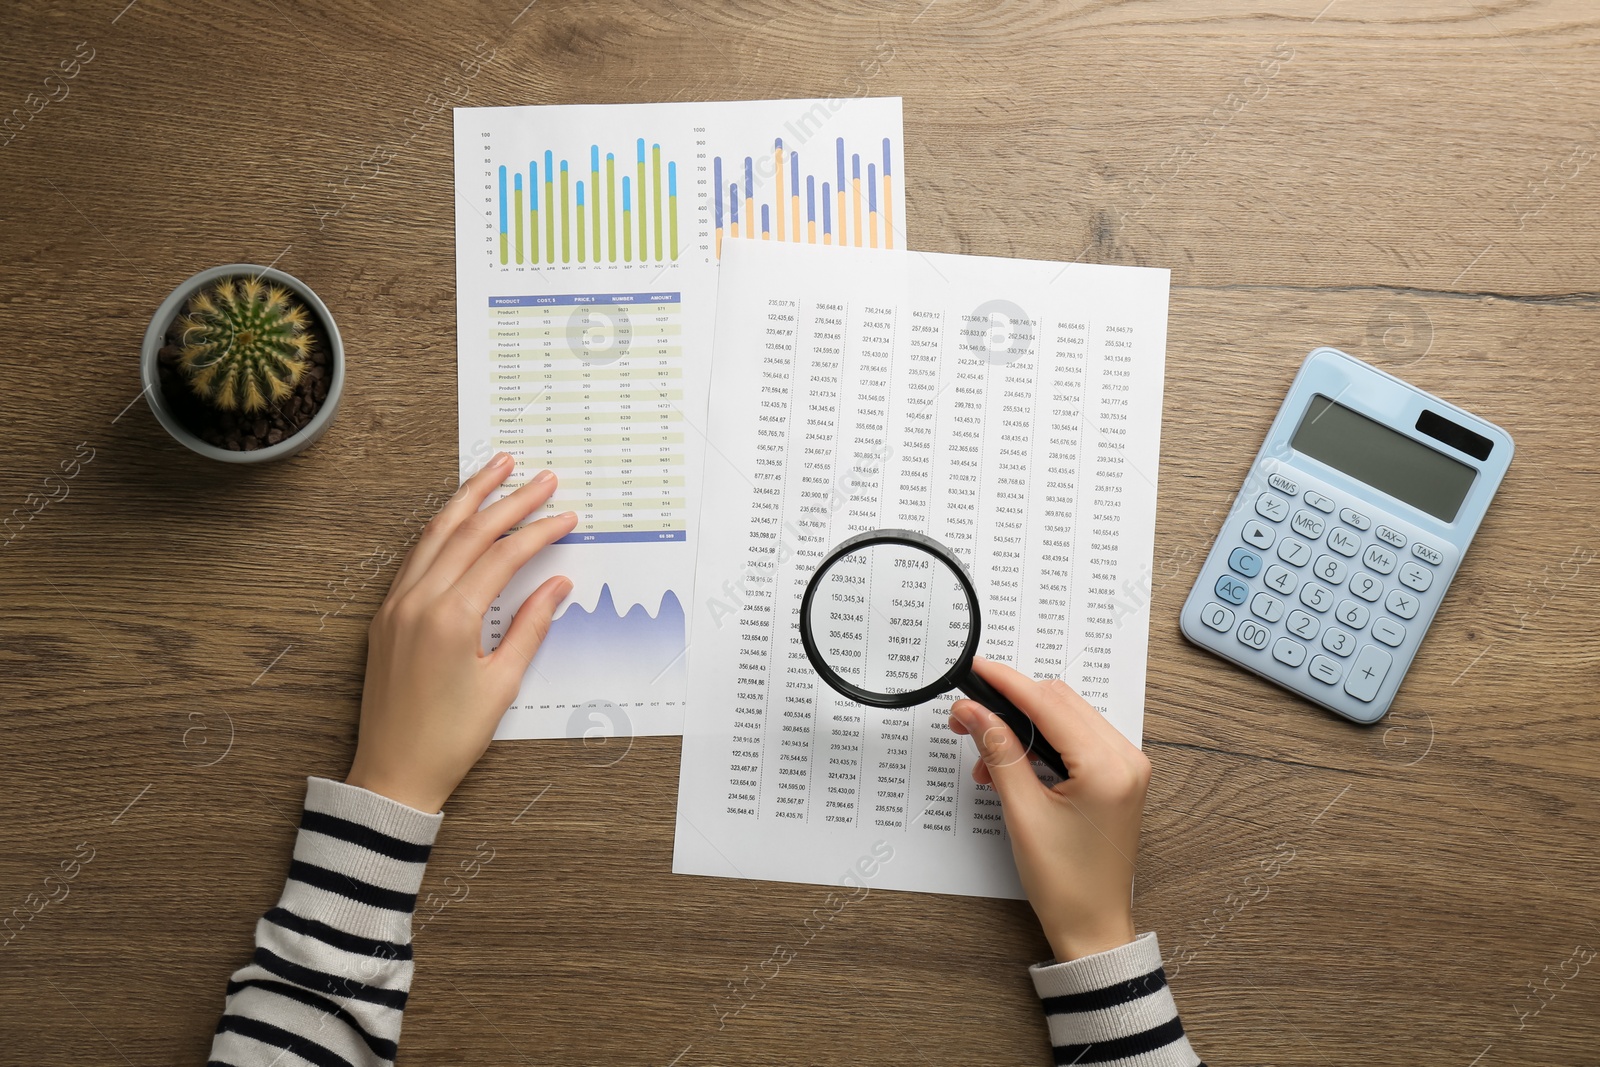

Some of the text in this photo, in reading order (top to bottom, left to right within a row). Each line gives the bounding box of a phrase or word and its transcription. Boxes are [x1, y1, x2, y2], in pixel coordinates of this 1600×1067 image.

[1273, 477, 1296, 492] H/M/S
[1295, 515, 1322, 534] MRC
[1291, 544, 1302, 558] 7
[1416, 545, 1438, 561] TAX+
[894, 559, 928, 569] 378,974,43
[1239, 556, 1253, 570] C
[1369, 551, 1389, 566] M+
[1325, 562, 1337, 577] 8
[832, 574, 865, 584] 239,343,34
[902, 581, 926, 589] 213,343
[1276, 574, 1288, 588] 4
[1220, 582, 1244, 600] AC
[1363, 579, 1373, 594] 9
[832, 594, 864, 603] 150,345,34
[892, 599, 924, 608] 154,345,34
[1311, 589, 1324, 605] 5
[1266, 601, 1273, 615] 1
[1347, 607, 1357, 621] 6
[830, 612, 863, 622] 324,334,45
[890, 618, 922, 626] 367,823,54
[1212, 610, 1225, 625] 0
[1297, 618, 1310, 634] 2
[830, 631, 862, 640] 305,455,45
[889, 636, 921, 645] 316,911,22
[1243, 625, 1265, 645] 00
[1333, 635, 1345, 650] 3
[830, 649, 861, 657] 125,430,00
[888, 654, 919, 662] 127,938,47
[886, 671, 917, 679] 235,575,56
